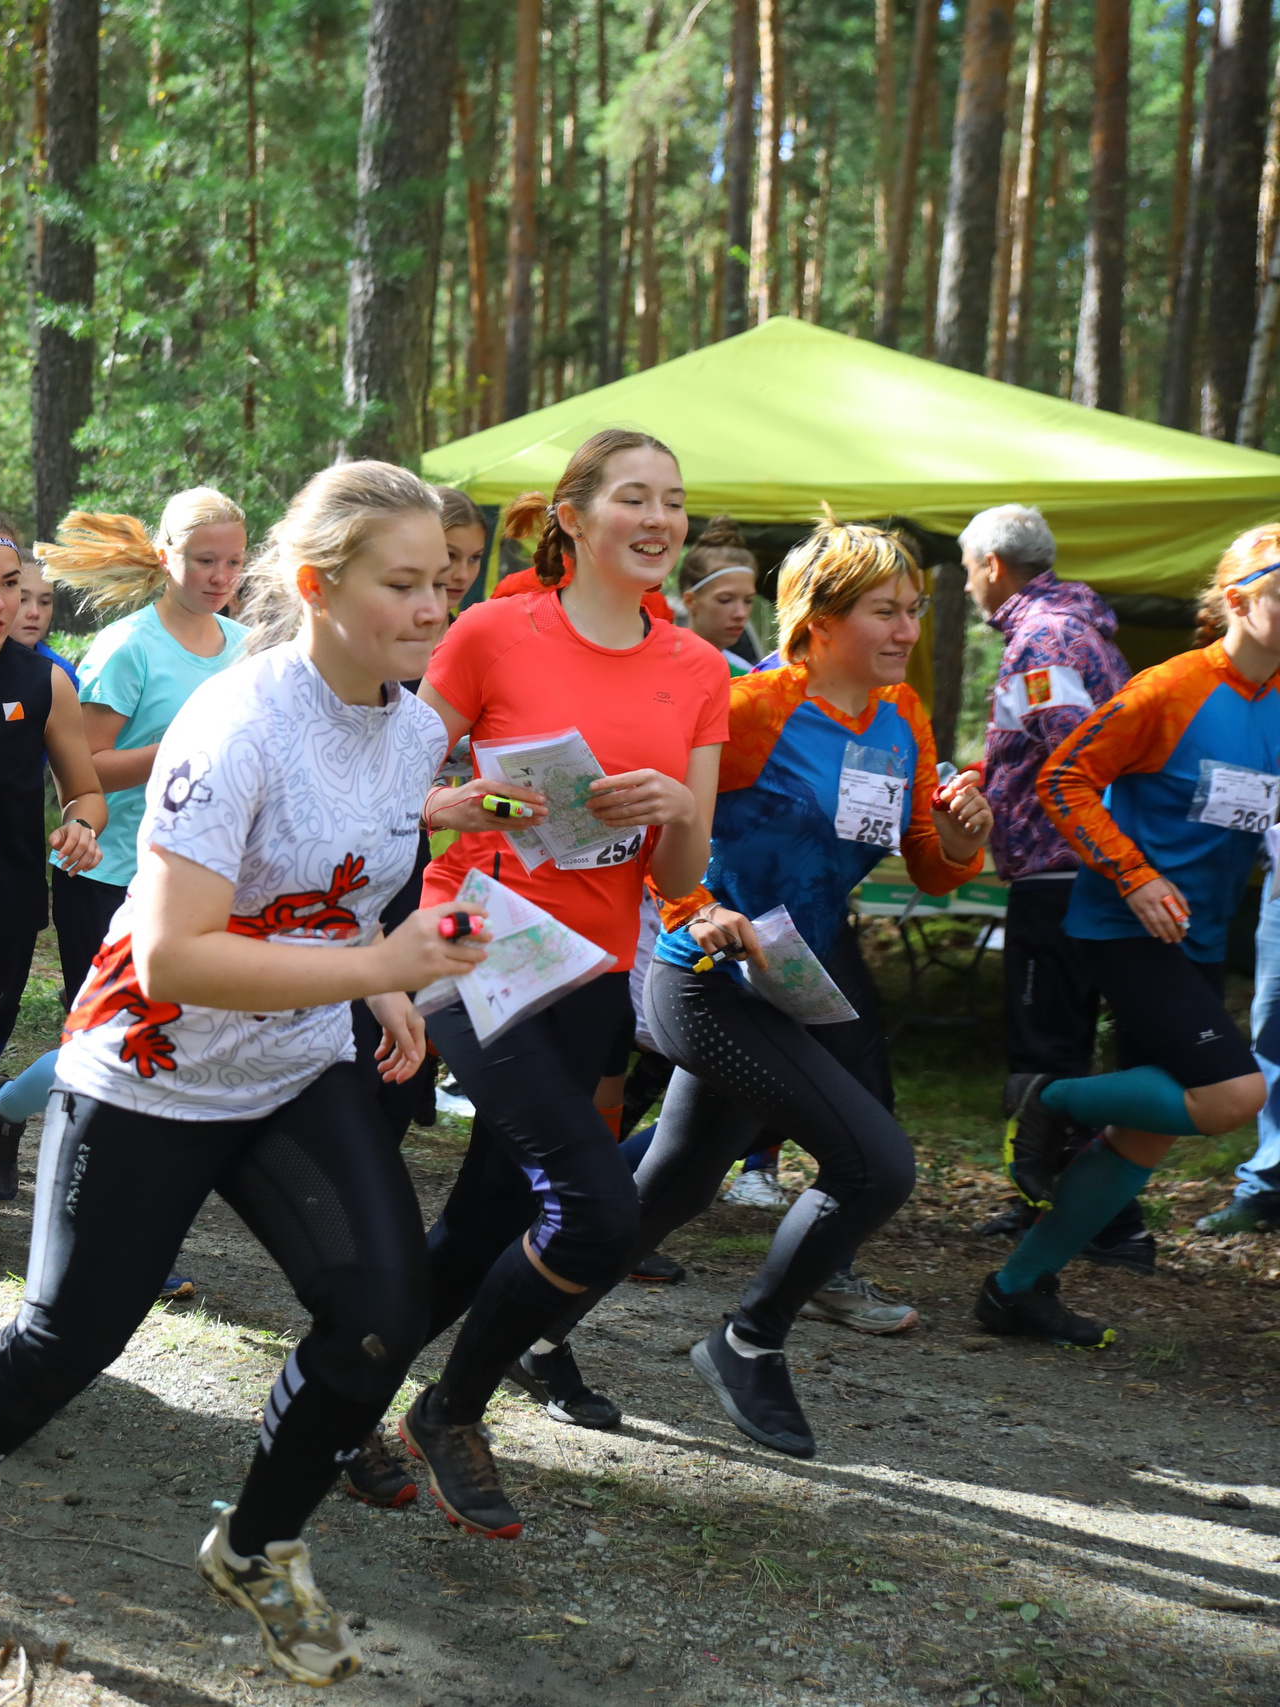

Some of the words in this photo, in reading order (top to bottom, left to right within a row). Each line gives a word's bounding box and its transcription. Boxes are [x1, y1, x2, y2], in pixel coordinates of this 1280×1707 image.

[856, 816, 893, 846] 255
[1228, 809, 1270, 831] 260
[596, 833, 642, 865] 254
